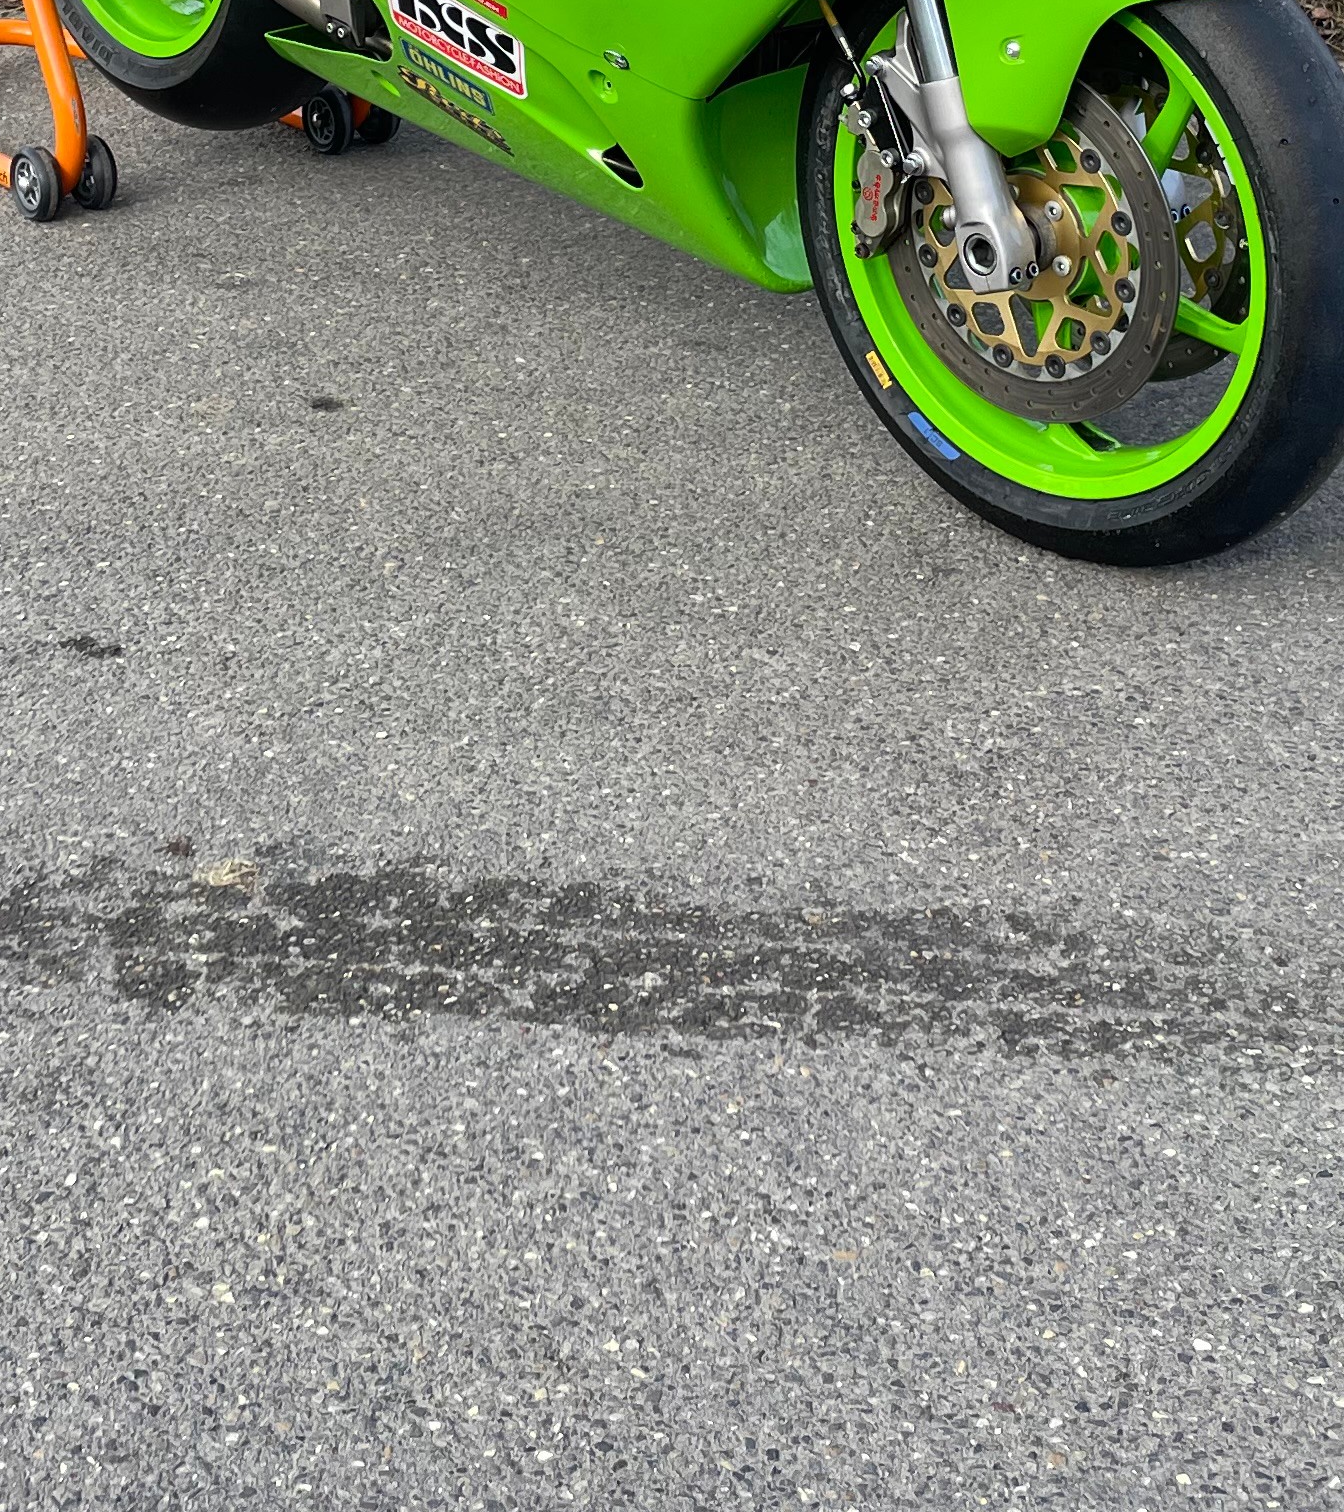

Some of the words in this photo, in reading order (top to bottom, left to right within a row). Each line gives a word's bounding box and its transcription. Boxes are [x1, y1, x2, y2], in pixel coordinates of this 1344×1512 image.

[398, 16, 469, 65] MOTORCYCLE
[469, 55, 520, 93] FASHION
[408, 43, 487, 107] ÖHLINS
